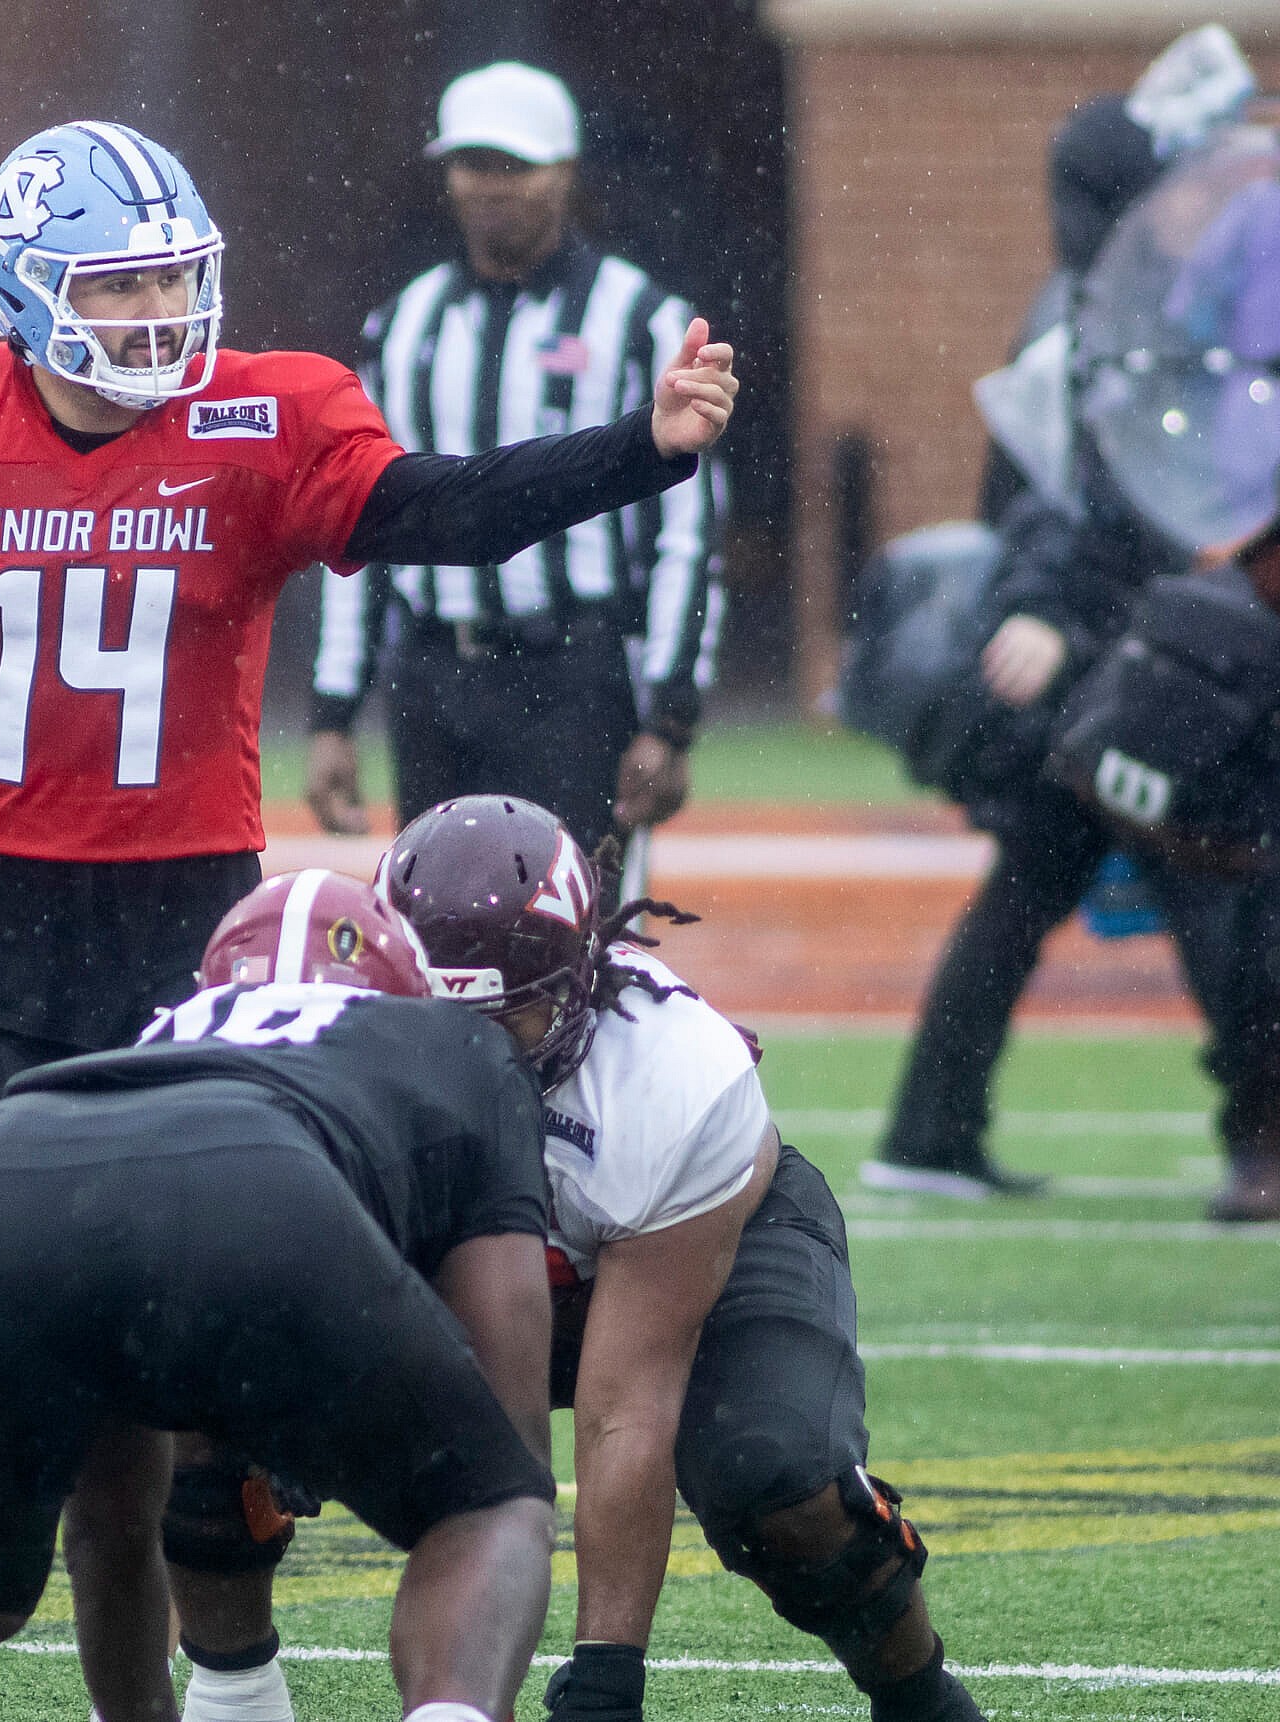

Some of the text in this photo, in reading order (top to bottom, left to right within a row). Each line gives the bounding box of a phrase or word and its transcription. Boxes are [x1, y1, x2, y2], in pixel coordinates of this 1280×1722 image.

[198, 403, 269, 424] WALK-ON'S
[108, 507, 215, 552] BOWL
[441, 975, 475, 994] VT
